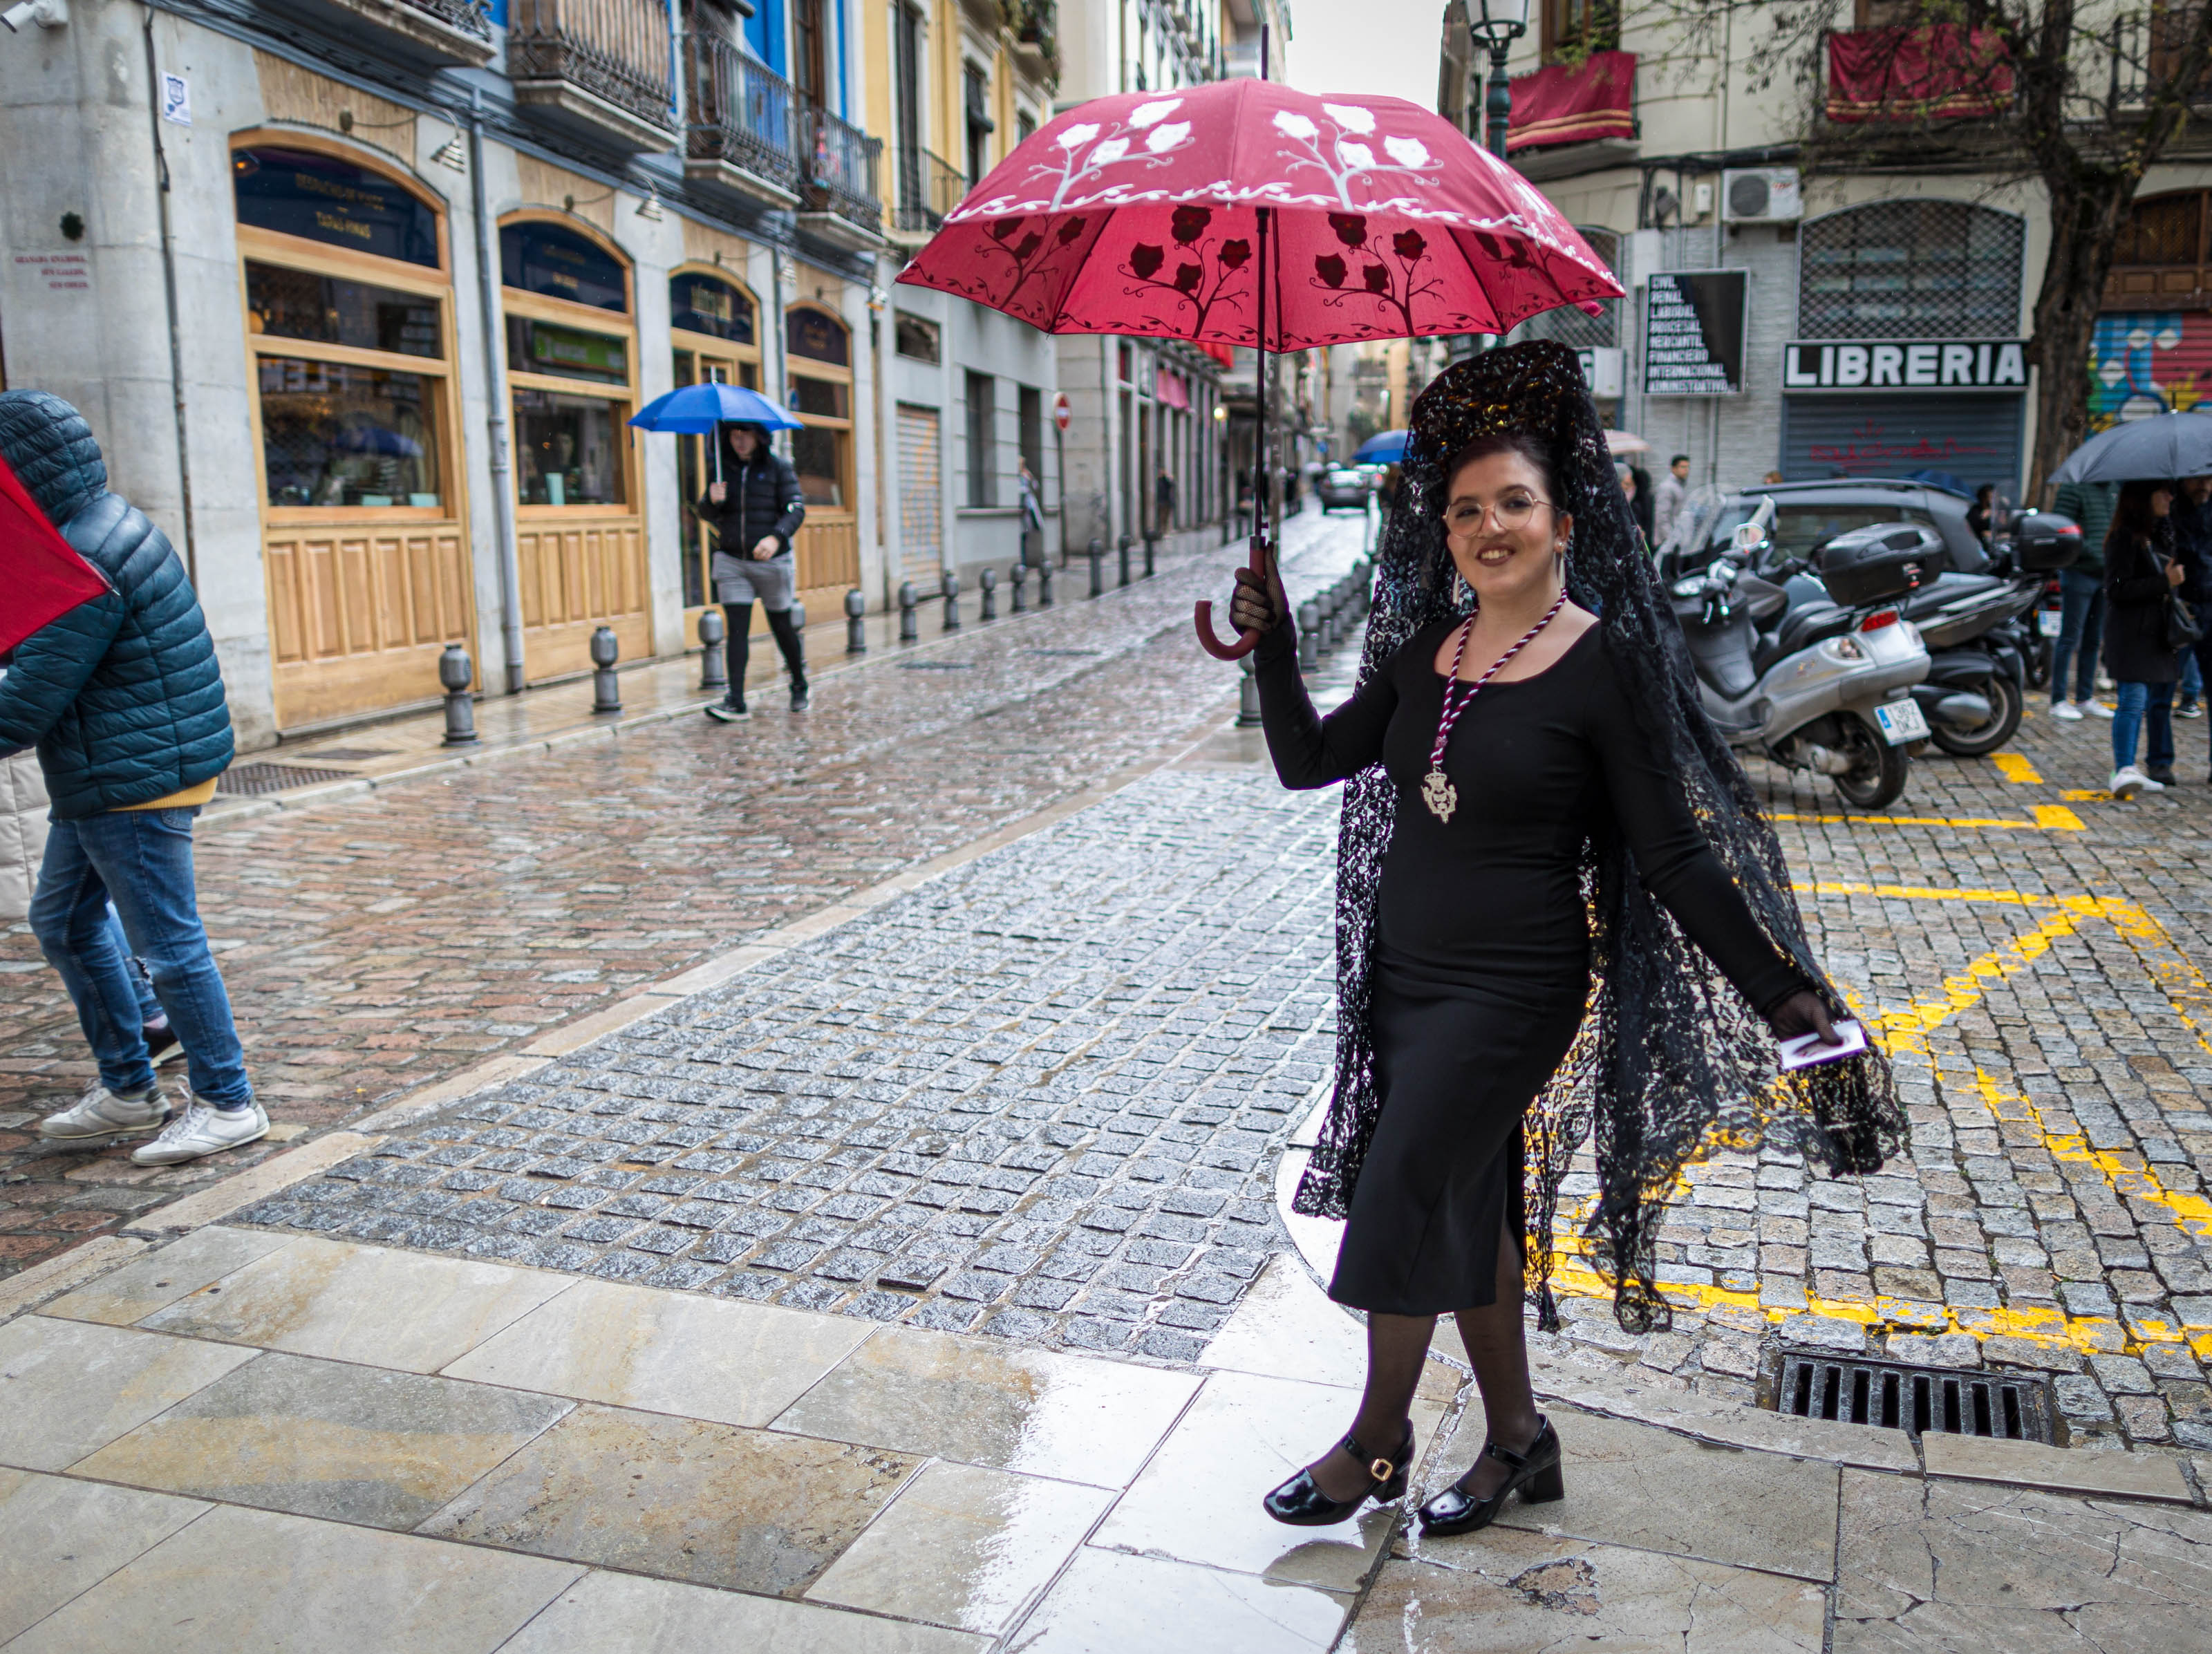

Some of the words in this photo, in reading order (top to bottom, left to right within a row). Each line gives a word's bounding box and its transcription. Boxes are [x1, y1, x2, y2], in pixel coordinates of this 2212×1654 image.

[1649, 304, 1697, 319] LABORAL
[1649, 348, 1709, 362] FINANCIERO
[1648, 363, 1727, 378] INTERNACIONAL
[1786, 344, 2025, 386] LIBRERIA
